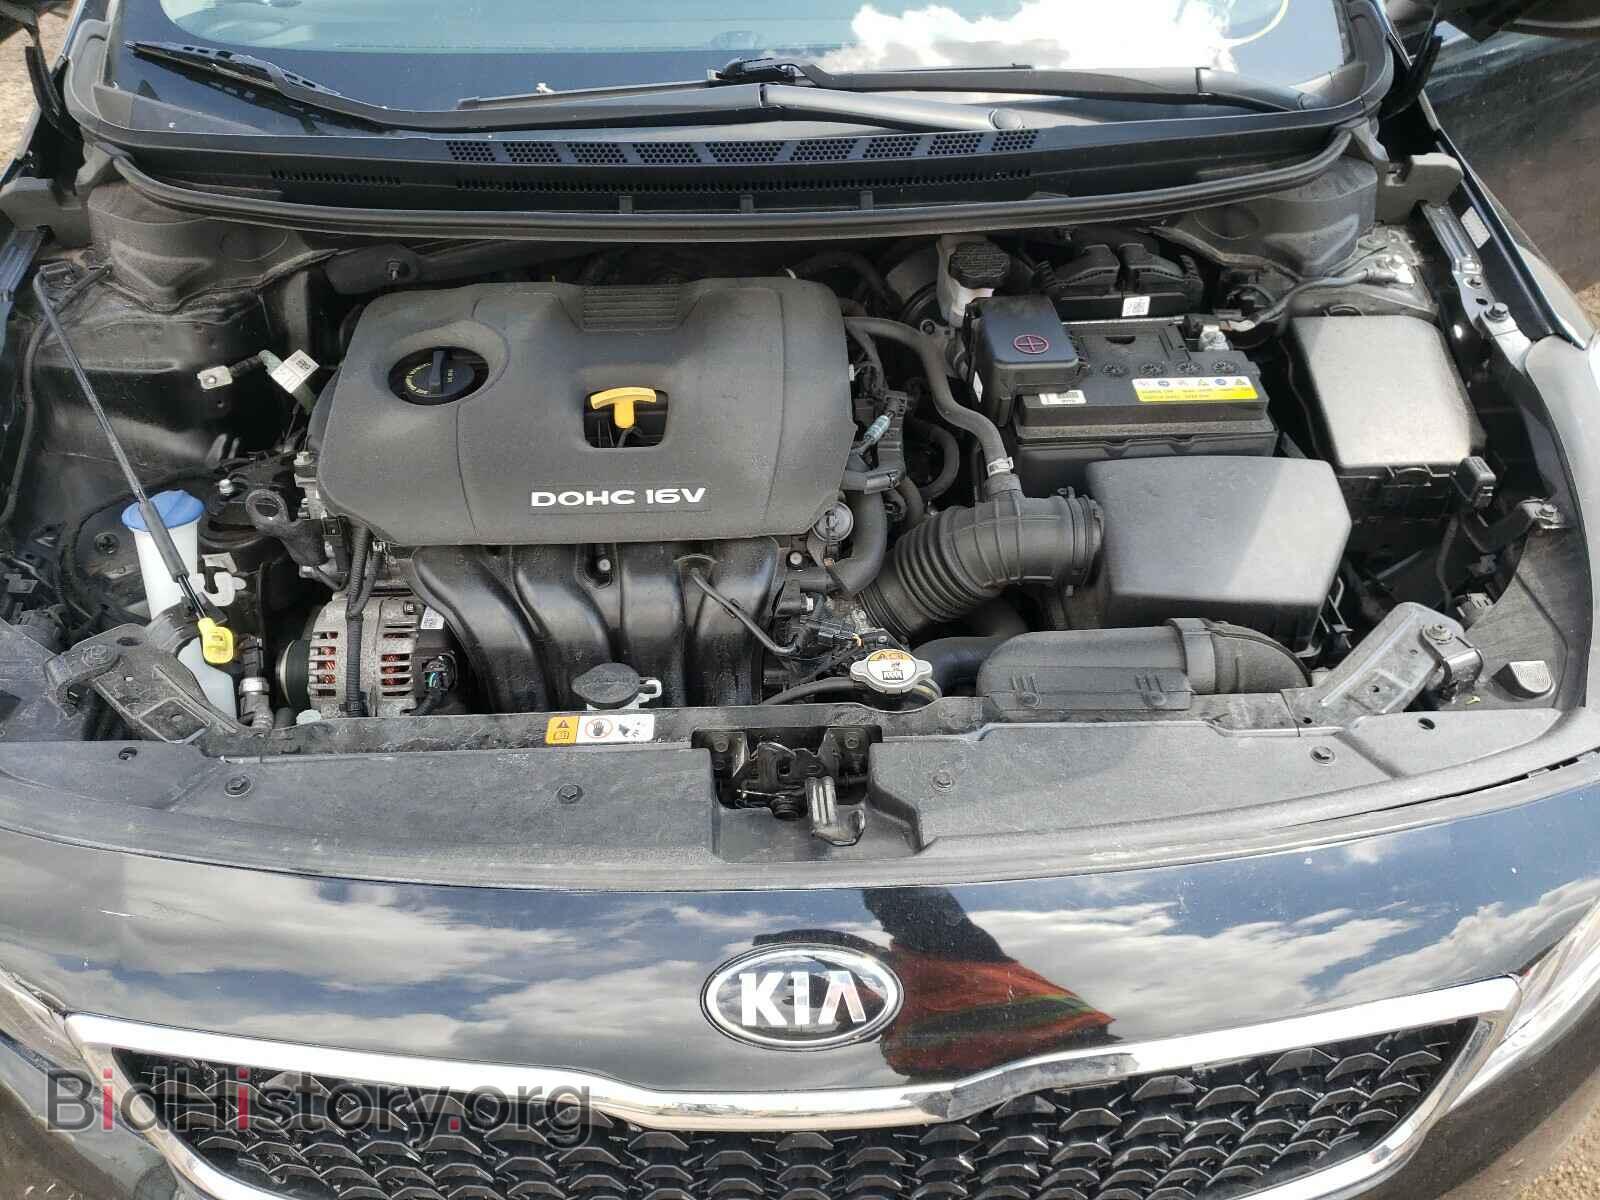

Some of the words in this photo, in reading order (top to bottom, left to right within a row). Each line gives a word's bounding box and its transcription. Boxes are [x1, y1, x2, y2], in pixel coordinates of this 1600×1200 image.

[531, 490, 636, 507] DOHC
[645, 487, 706, 504] 16V
[738, 971, 867, 1026] KIA
